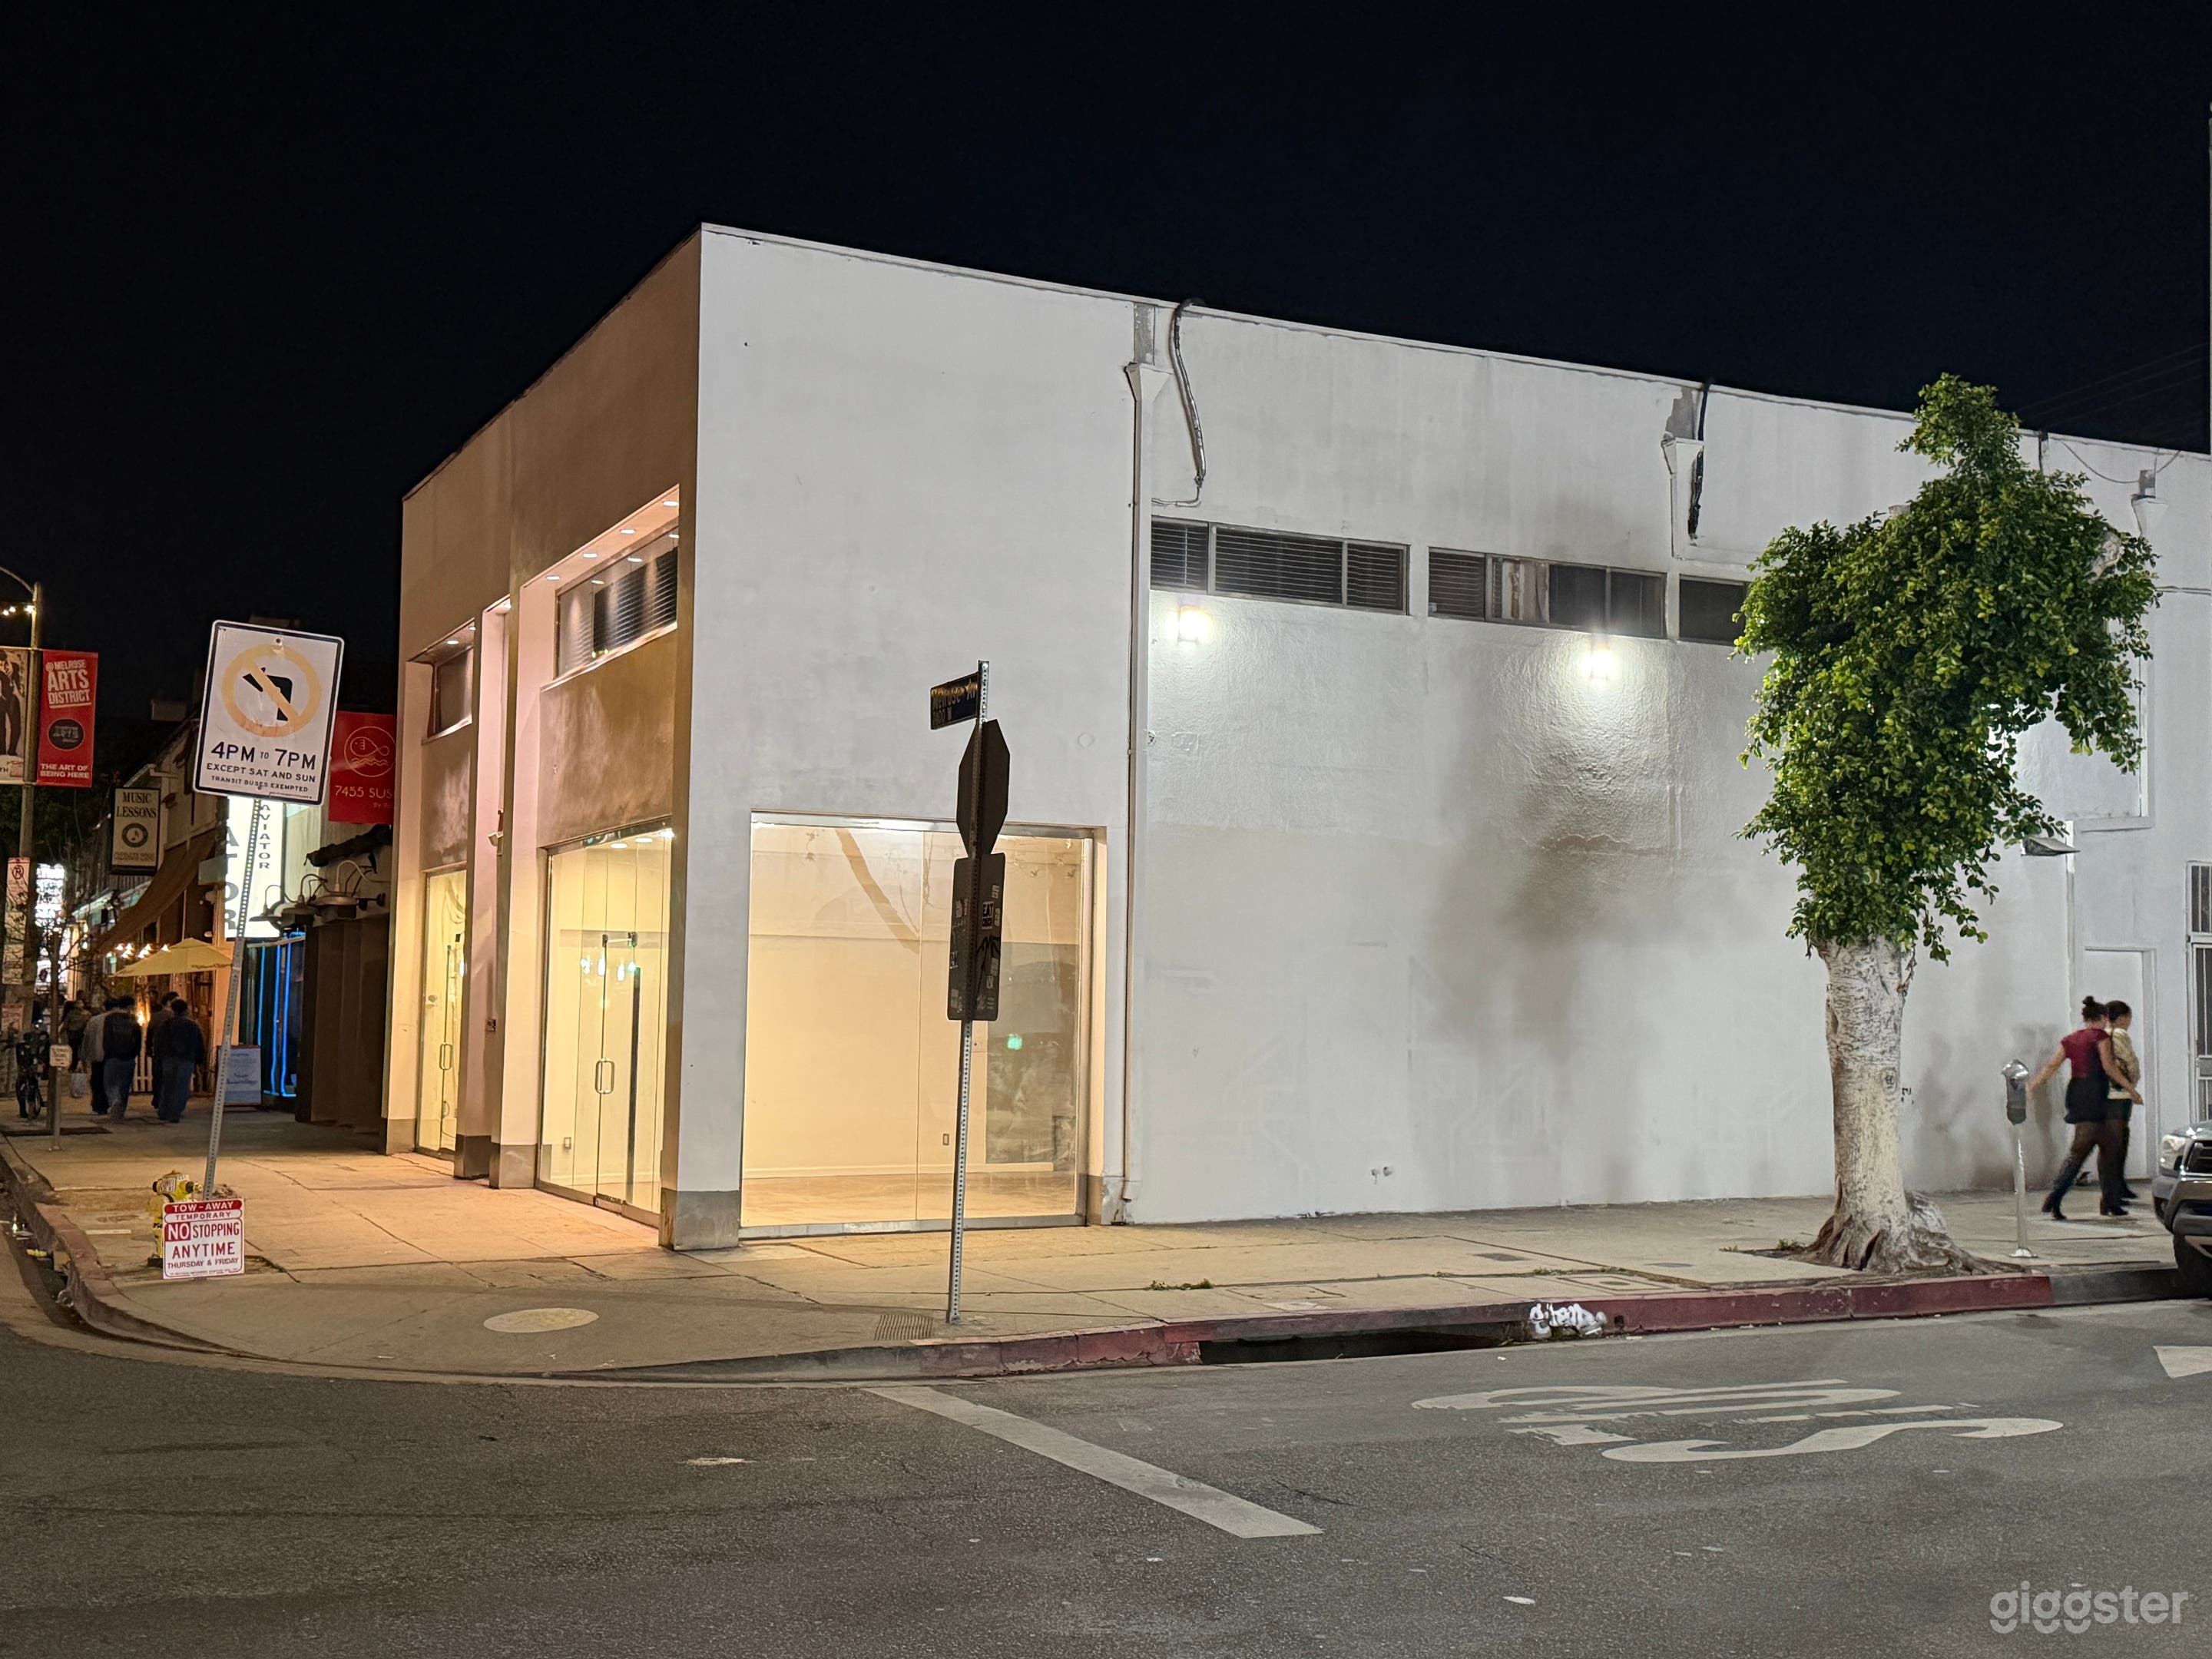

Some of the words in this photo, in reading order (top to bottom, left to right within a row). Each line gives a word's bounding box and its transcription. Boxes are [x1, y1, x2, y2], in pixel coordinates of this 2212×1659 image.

[54, 660, 86, 670] MELROSE
[48, 669, 89, 691] ARTS
[48, 690, 90, 704] DISTRICT
[211, 741, 255, 763] 4PM
[260, 751, 269, 760] TO
[275, 748, 316, 770] 7PM
[207, 763, 247, 775] EXCEPT
[249, 768, 269, 777] SAT
[271, 770, 292, 780] AND
[296, 773, 316, 783] SUN
[211, 775, 242, 785] TRANSIT
[244, 780, 268, 788] BUSES
[270, 783, 309, 793] EXEMPTED
[335, 785, 364, 798] 7455
[122, 792, 151, 804] MUSIC
[116, 806, 157, 819] LESSONS
[259, 804, 270, 869] AVIATOR
[175, 1212, 231, 1220] TEMPORARY
[167, 1223, 190, 1240] NO
[192, 1222, 240, 1239] STOPPING
[171, 1241, 236, 1260] ANYTIME
[167, 1260, 204, 1269] THURSDAY
[215, 1257, 239, 1266] FRIDAY
